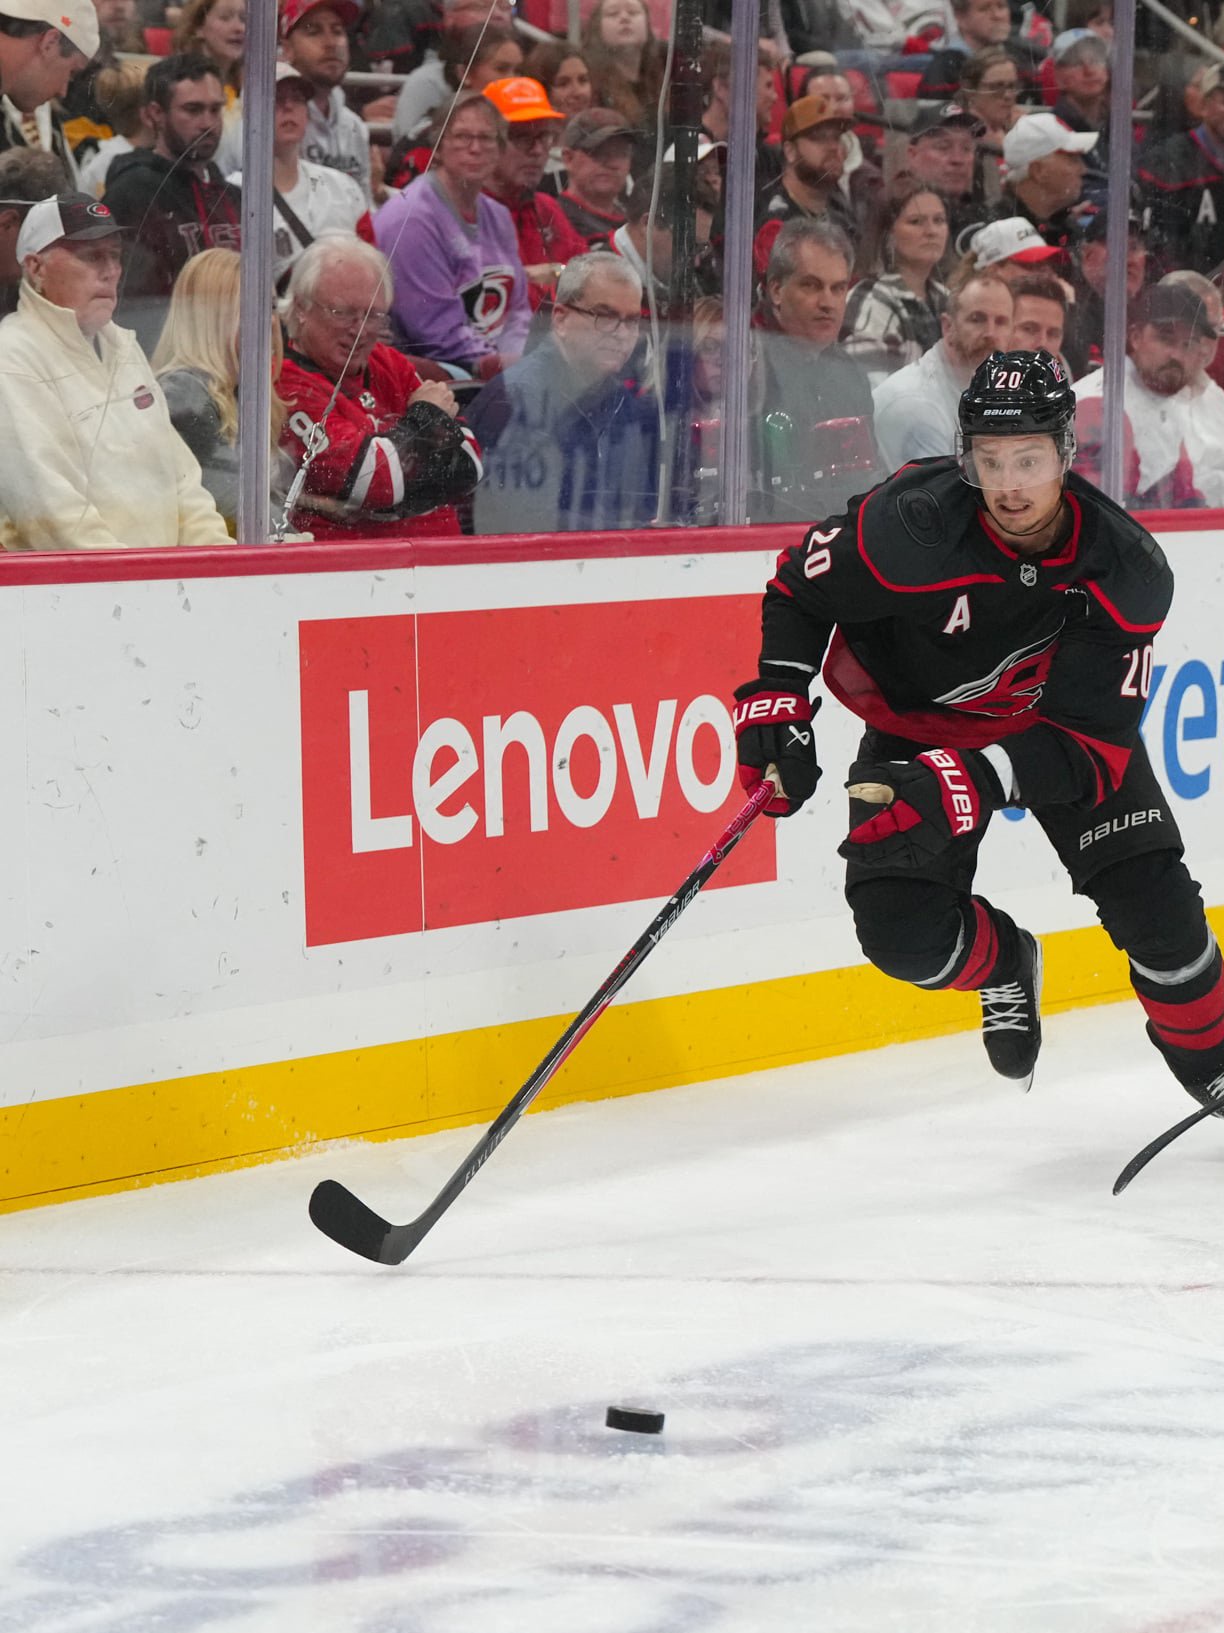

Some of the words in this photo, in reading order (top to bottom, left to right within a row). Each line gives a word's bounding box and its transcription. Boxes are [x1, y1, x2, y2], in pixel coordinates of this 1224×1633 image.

[1196, 188, 1218, 225] A
[995, 371, 1021, 389] 20
[804, 527, 843, 580] 20
[942, 594, 971, 634] A
[1120, 644, 1154, 698] 20
[733, 697, 797, 732] UER
[348, 694, 737, 854] Lenovo
